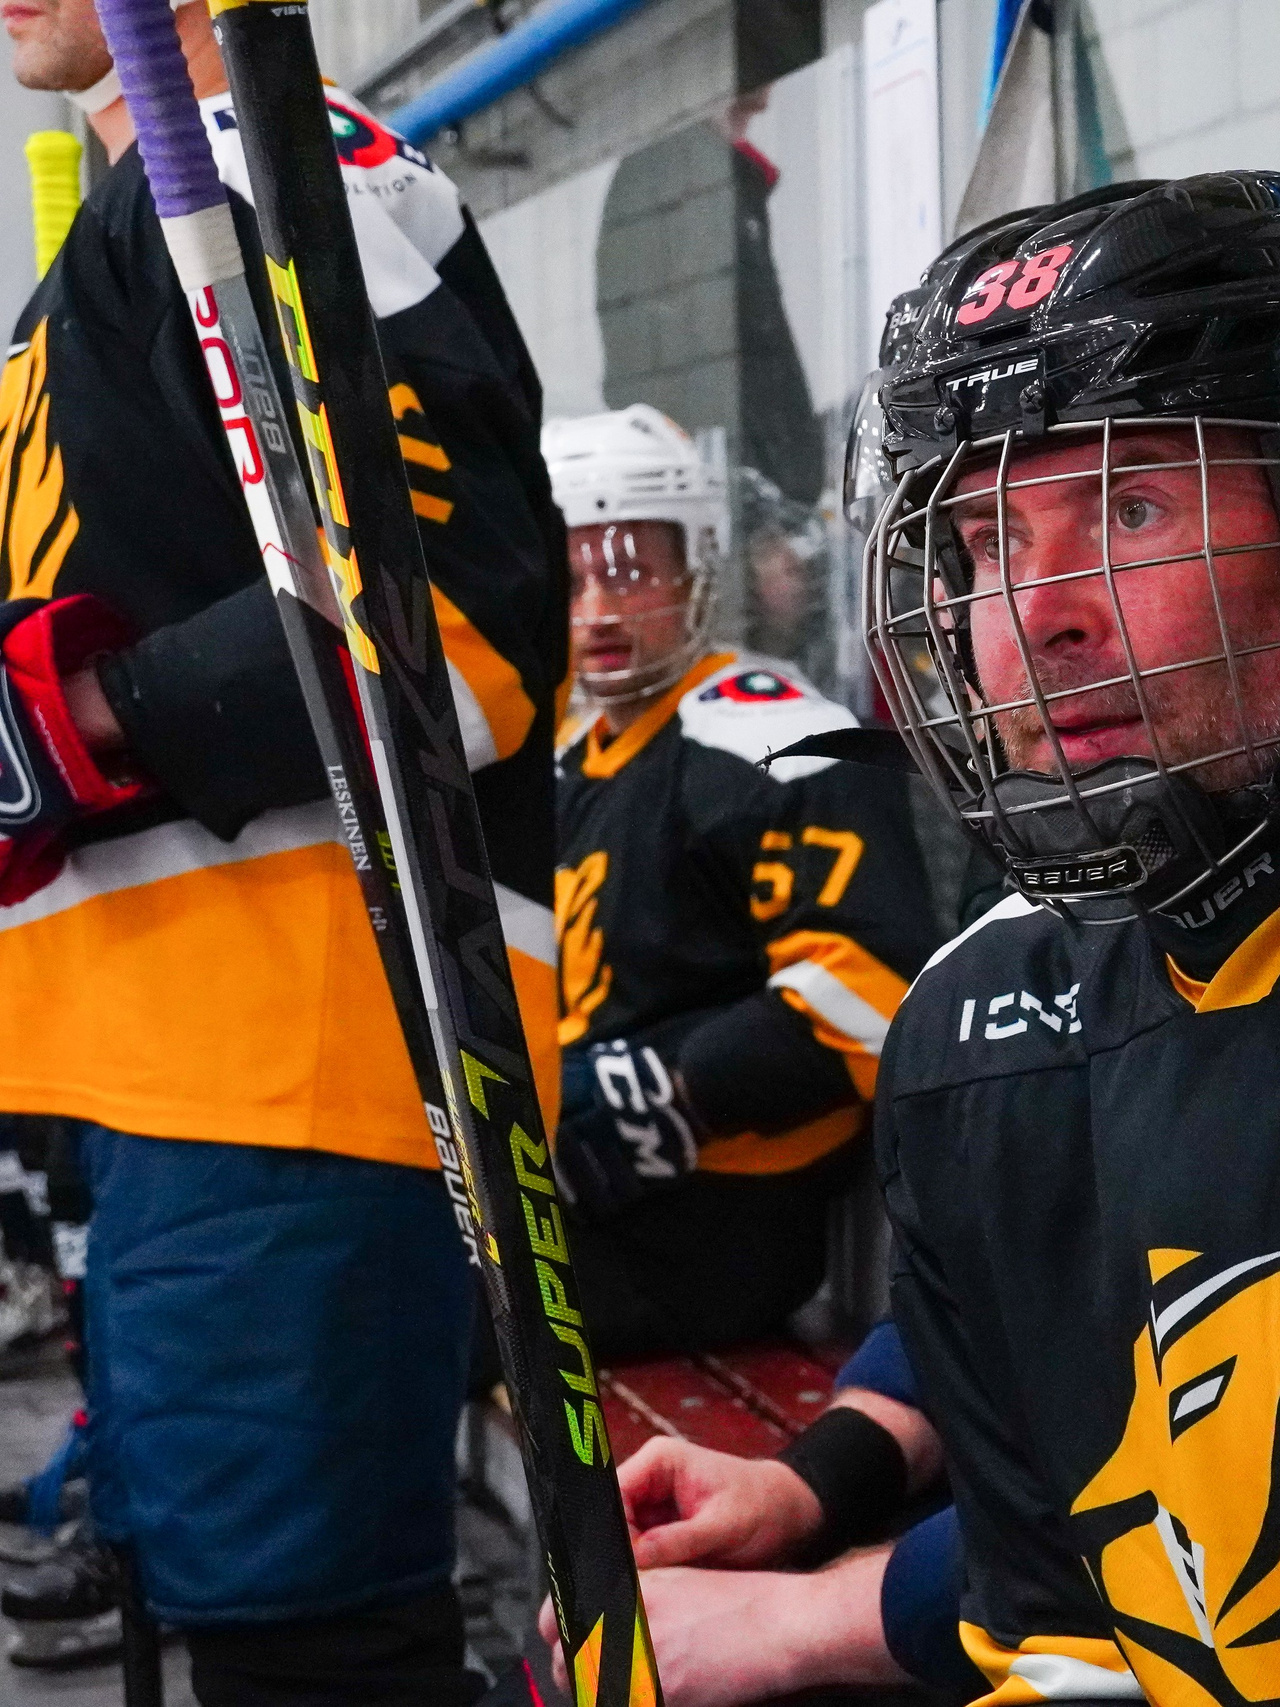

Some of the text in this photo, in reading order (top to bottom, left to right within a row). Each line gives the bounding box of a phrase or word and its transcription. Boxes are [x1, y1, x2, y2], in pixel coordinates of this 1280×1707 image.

[957, 244, 1073, 326] 38
[946, 358, 1039, 391] TRUE
[328, 764, 372, 871] LESKINEN
[1023, 859, 1128, 885] BAUER
[1170, 852, 1275, 929] UER
[424, 1102, 482, 1268] BAUER
[509, 1121, 611, 1468] SUPER
